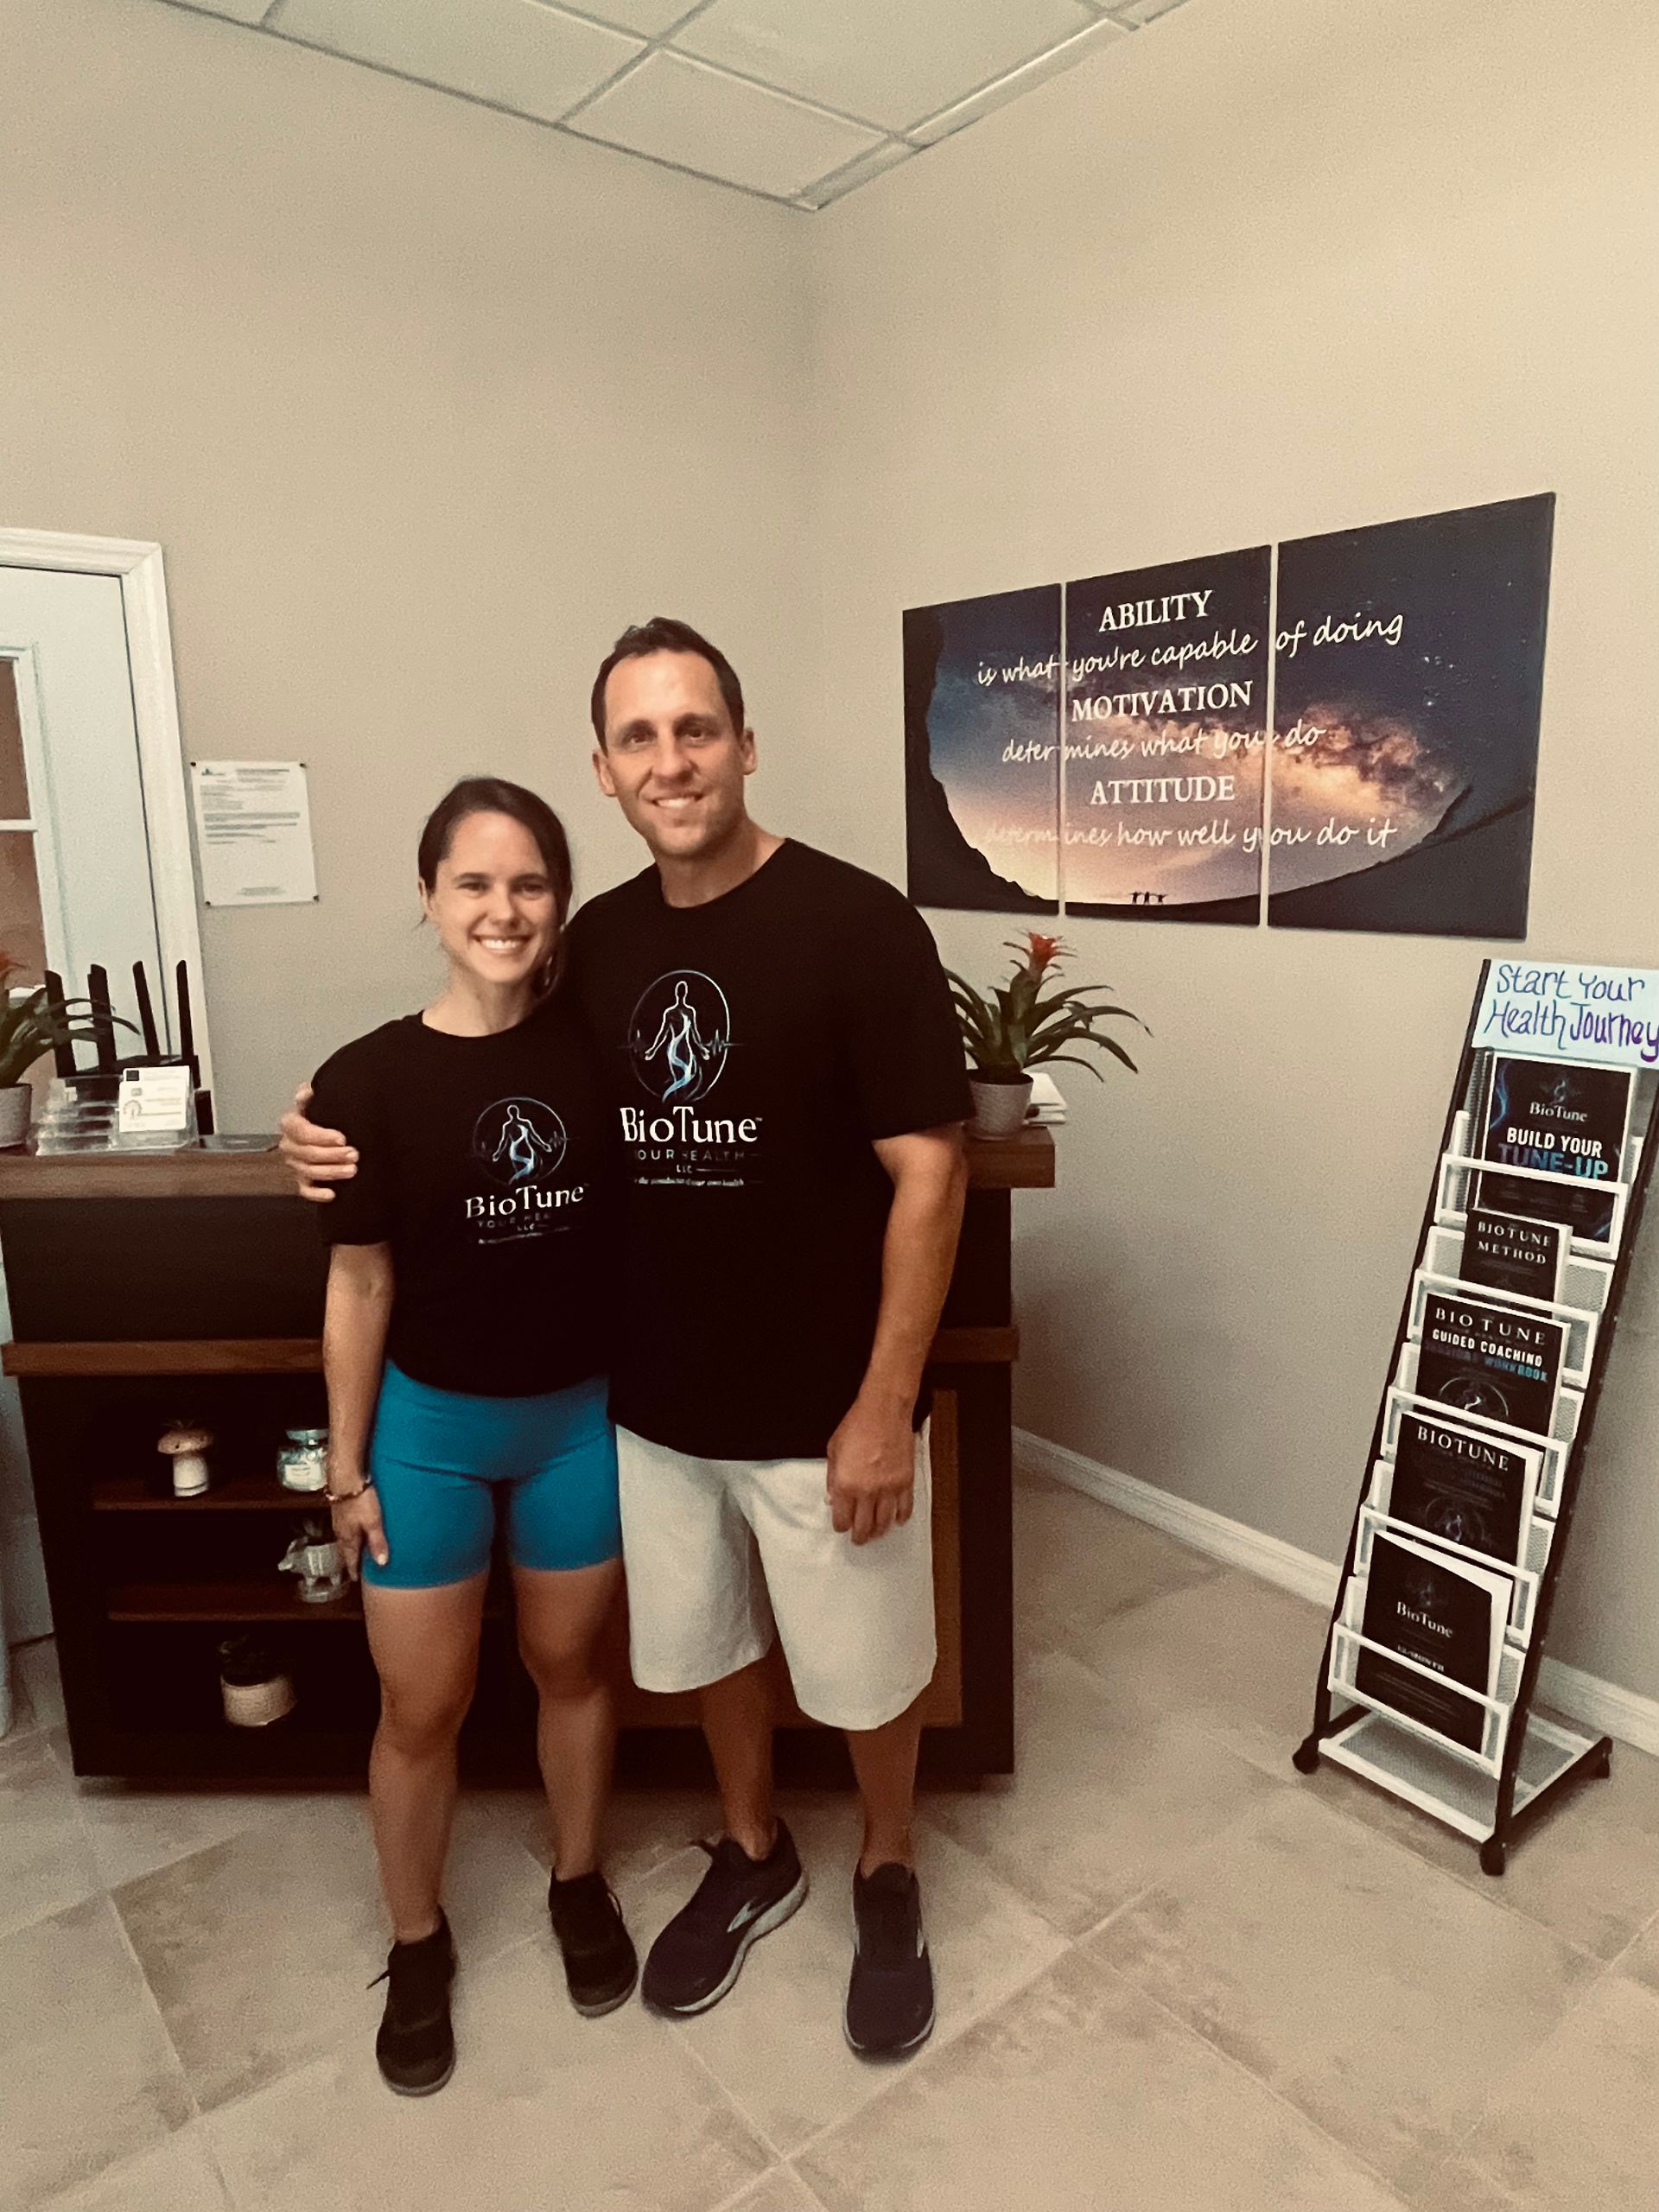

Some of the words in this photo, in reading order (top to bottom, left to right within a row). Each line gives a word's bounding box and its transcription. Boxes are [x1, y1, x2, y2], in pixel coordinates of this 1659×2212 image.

[1099, 590, 1212, 632] ABILITY
[978, 661, 997, 686] is
[1002, 655, 1060, 683] what
[1072, 646, 1147, 682] you're
[1151, 629, 1258, 670] capable
[1276, 620, 1307, 658] of
[1313, 612, 1403, 645] doing
[1071, 680, 1253, 721] MOTIVATION
[1141, 728, 1208, 756] what
[1212, 730, 1273, 759] you
[1284, 719, 1326, 747] do
[1090, 775, 1236, 804] ATTITUDE
[1117, 822, 1171, 846] how
[1178, 819, 1236, 844] well
[1243, 823, 1312, 853] you
[1317, 817, 1359, 845] do
[1367, 817, 1397, 847] it
[1497, 964, 1572, 999] Start
[1580, 972, 1645, 1001] Your
[1484, 999, 1567, 1050] Health
[1570, 1002, 1659, 1062] Journey
[620, 1106, 758, 1143] BioTune
[1529, 1102, 1588, 1122] BioTune
[1498, 1142, 1609, 1179] TUNE-UP
[1507, 1127, 1555, 1149] BUILD
[1560, 1135, 1602, 1158] YOUR
[465, 1185, 584, 1218] BioTune
[1478, 1221, 1552, 1247] BIOTUNE
[1478, 1240, 1547, 1264] METHOD
[1433, 1329, 1475, 1350] GUIDED
[1417, 1425, 1510, 1471] BIOTUNE
[1396, 1601, 1453, 1638] BioTune
